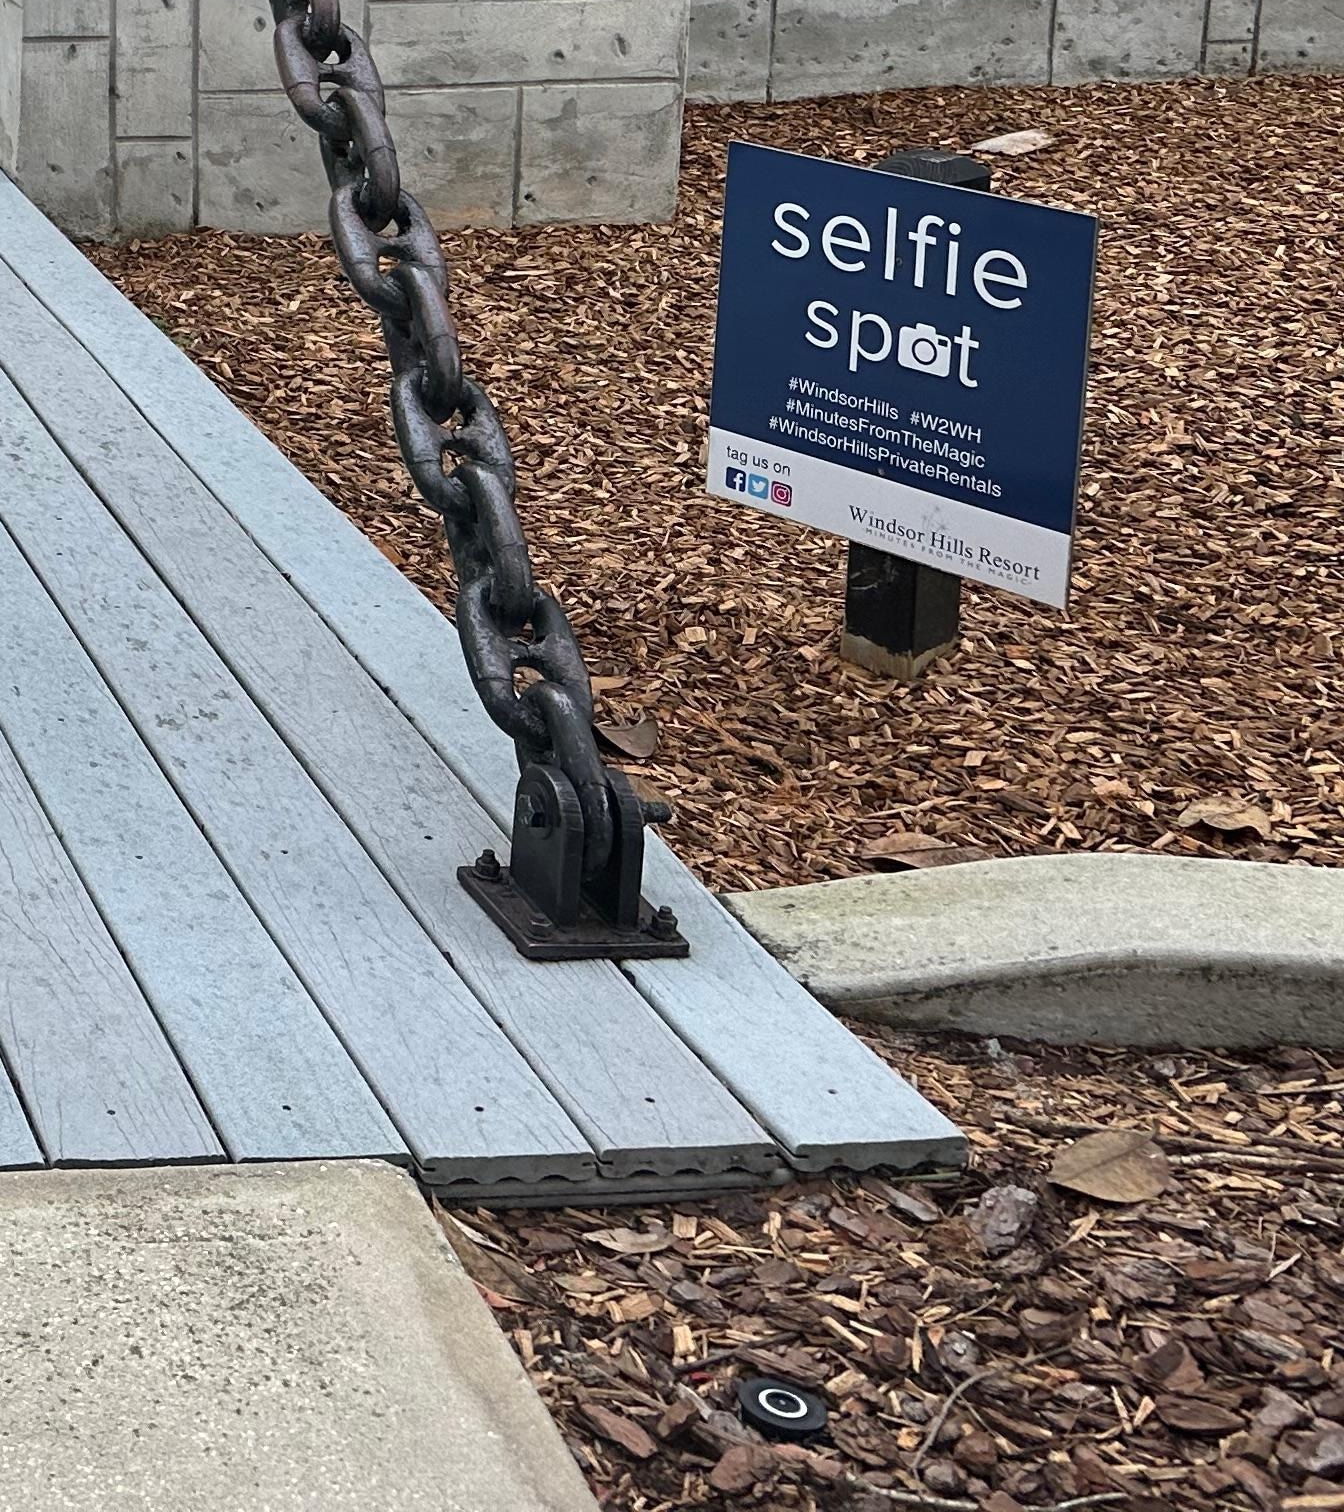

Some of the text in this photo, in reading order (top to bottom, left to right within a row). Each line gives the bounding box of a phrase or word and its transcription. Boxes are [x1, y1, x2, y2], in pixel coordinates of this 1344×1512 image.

[771, 202, 1028, 309] selfie
[785, 397, 986, 468] #MinutesFromTheMagic
[788, 376, 982, 444] #WindsorHills #W2WH
[726, 445, 791, 476] tag us on
[768, 416, 1002, 497] #WindsorHillsPrivateRentals
[849, 504, 1040, 581] Windsor Hills Resort
